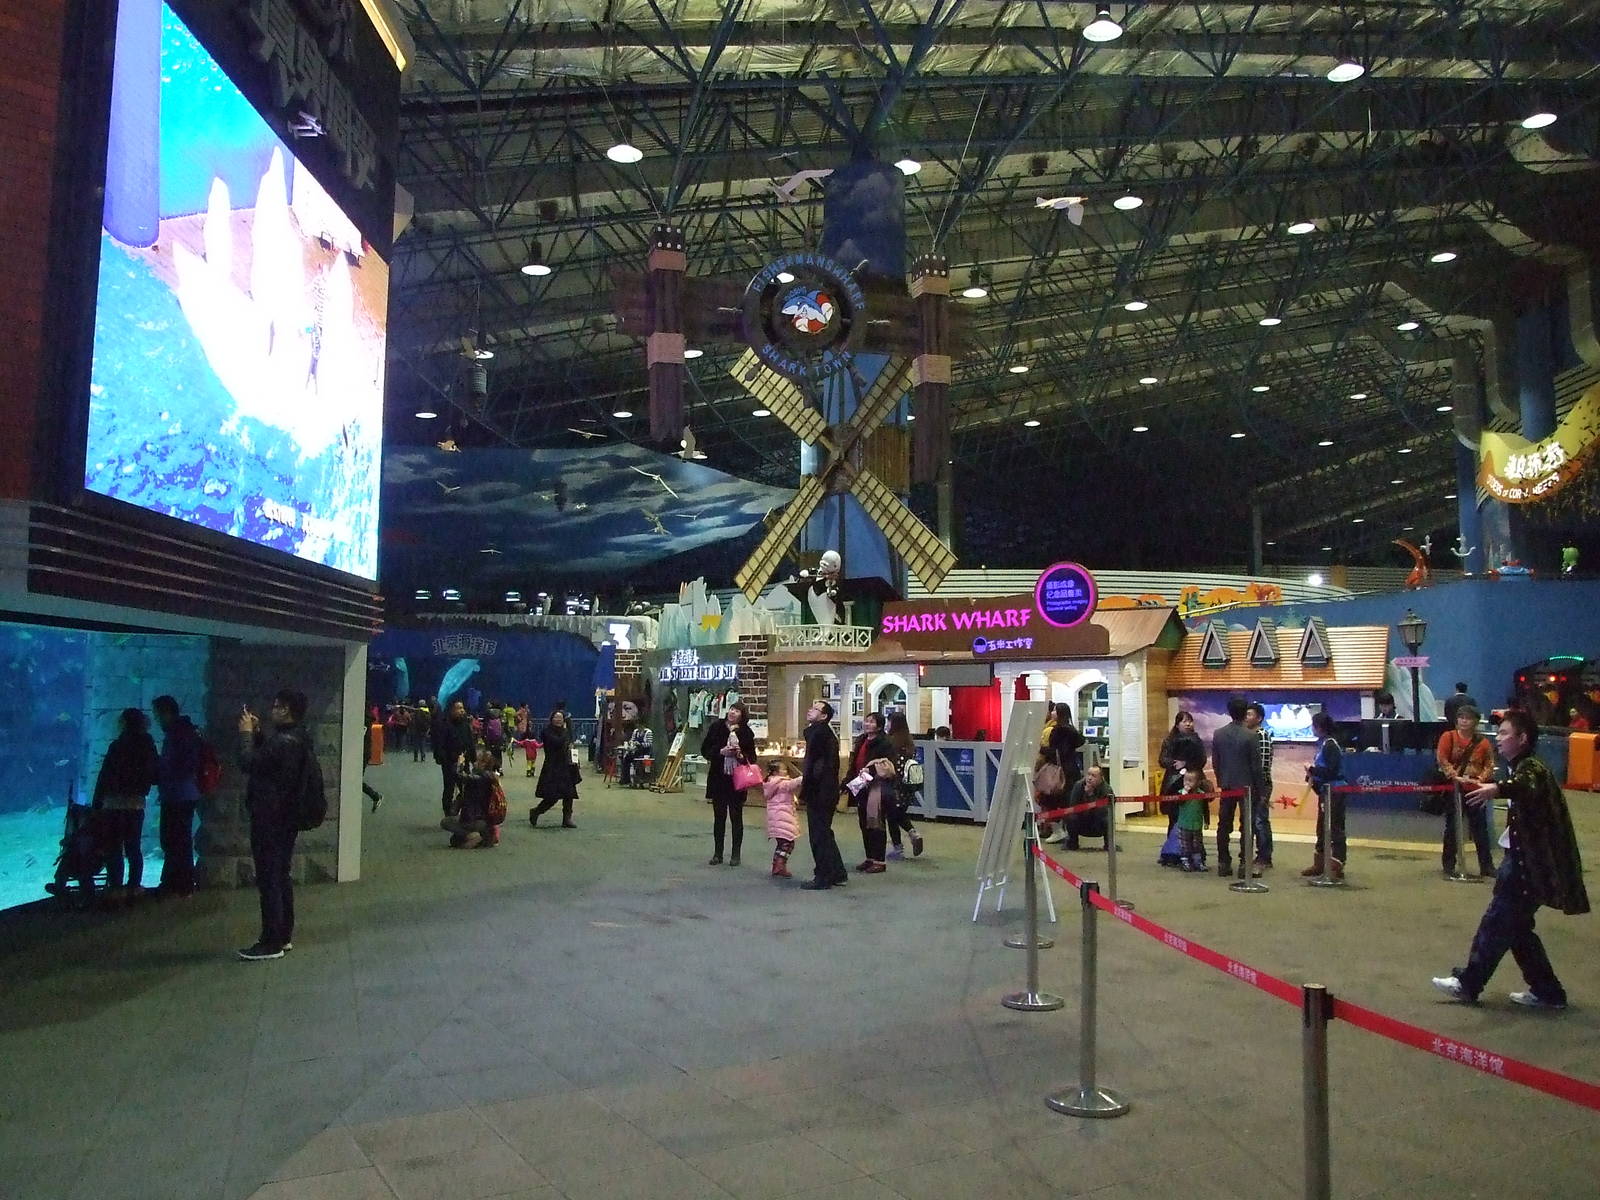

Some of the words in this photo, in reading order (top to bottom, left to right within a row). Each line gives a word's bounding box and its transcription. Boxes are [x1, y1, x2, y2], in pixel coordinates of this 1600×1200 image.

[762, 344, 807, 377] SHARK
[882, 612, 948, 634] SHARK
[951, 607, 1032, 631] WHARF
[1432, 1037, 1504, 1076] 北京海洋馆
